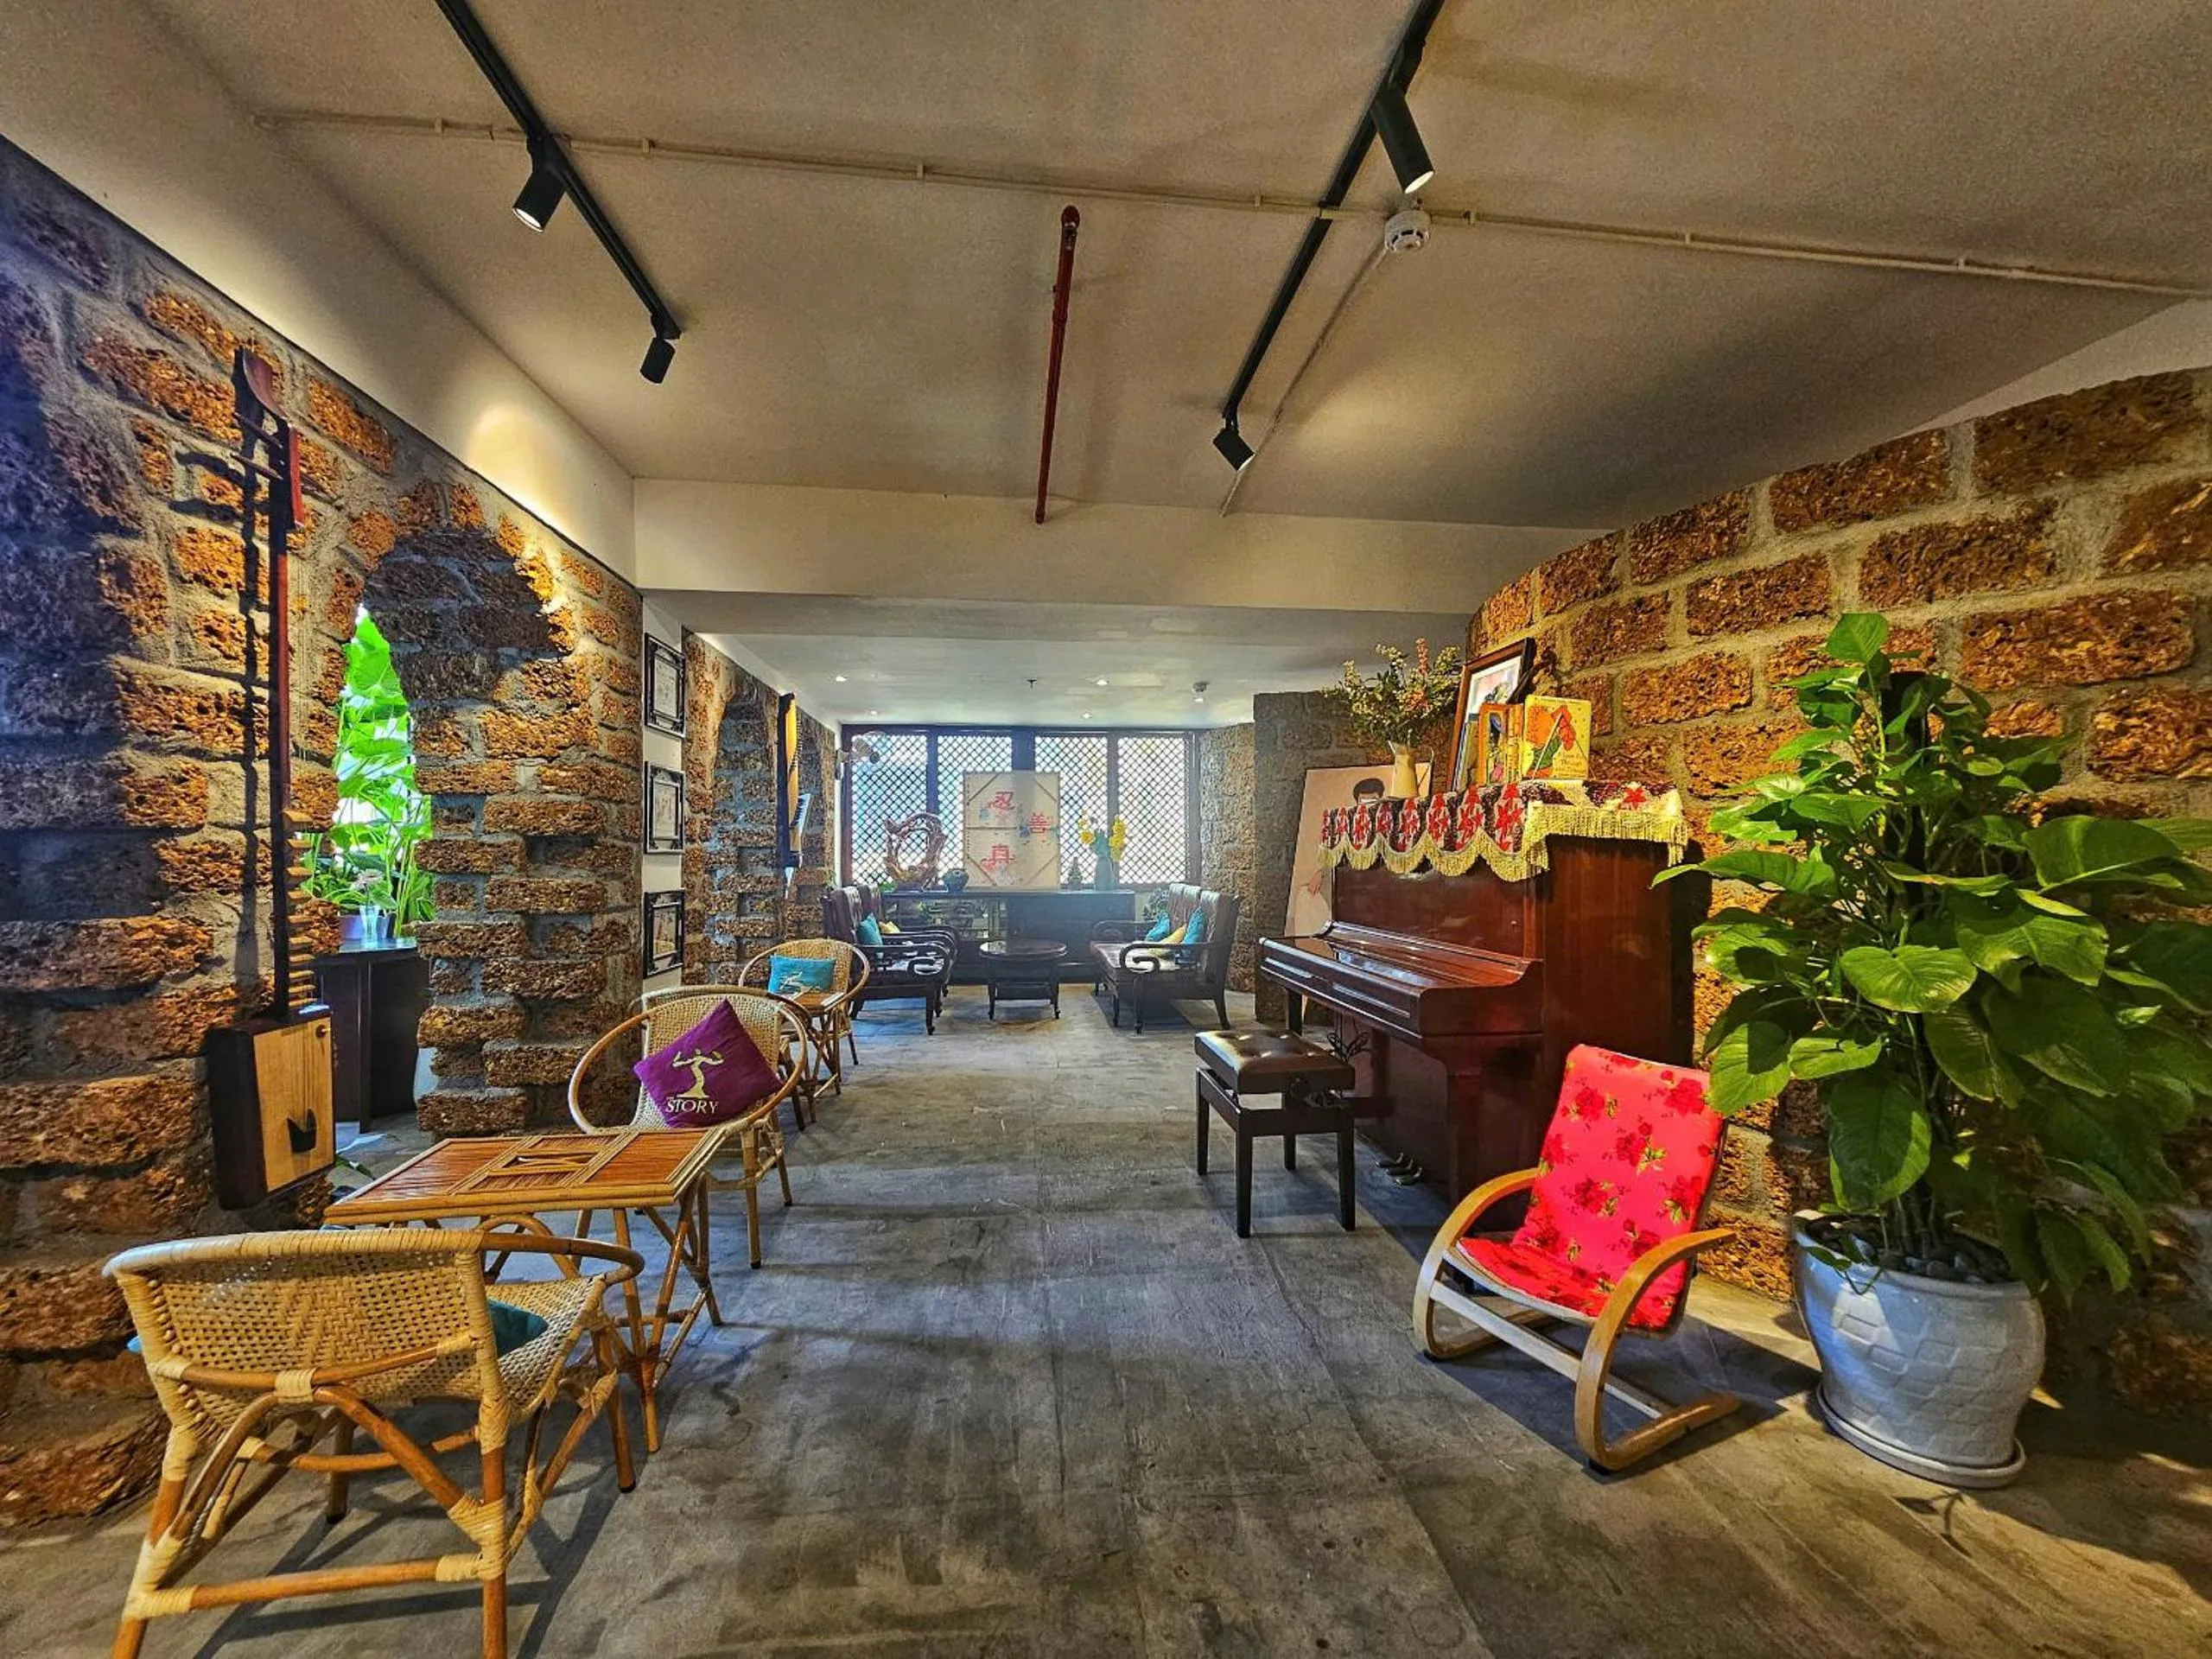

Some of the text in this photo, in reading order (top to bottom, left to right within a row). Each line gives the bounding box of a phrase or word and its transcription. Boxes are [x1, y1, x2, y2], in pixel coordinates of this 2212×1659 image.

[988, 791, 1015, 811] 忍
[1027, 812, 1051, 834] 善
[665, 1098, 719, 1115] STORY
